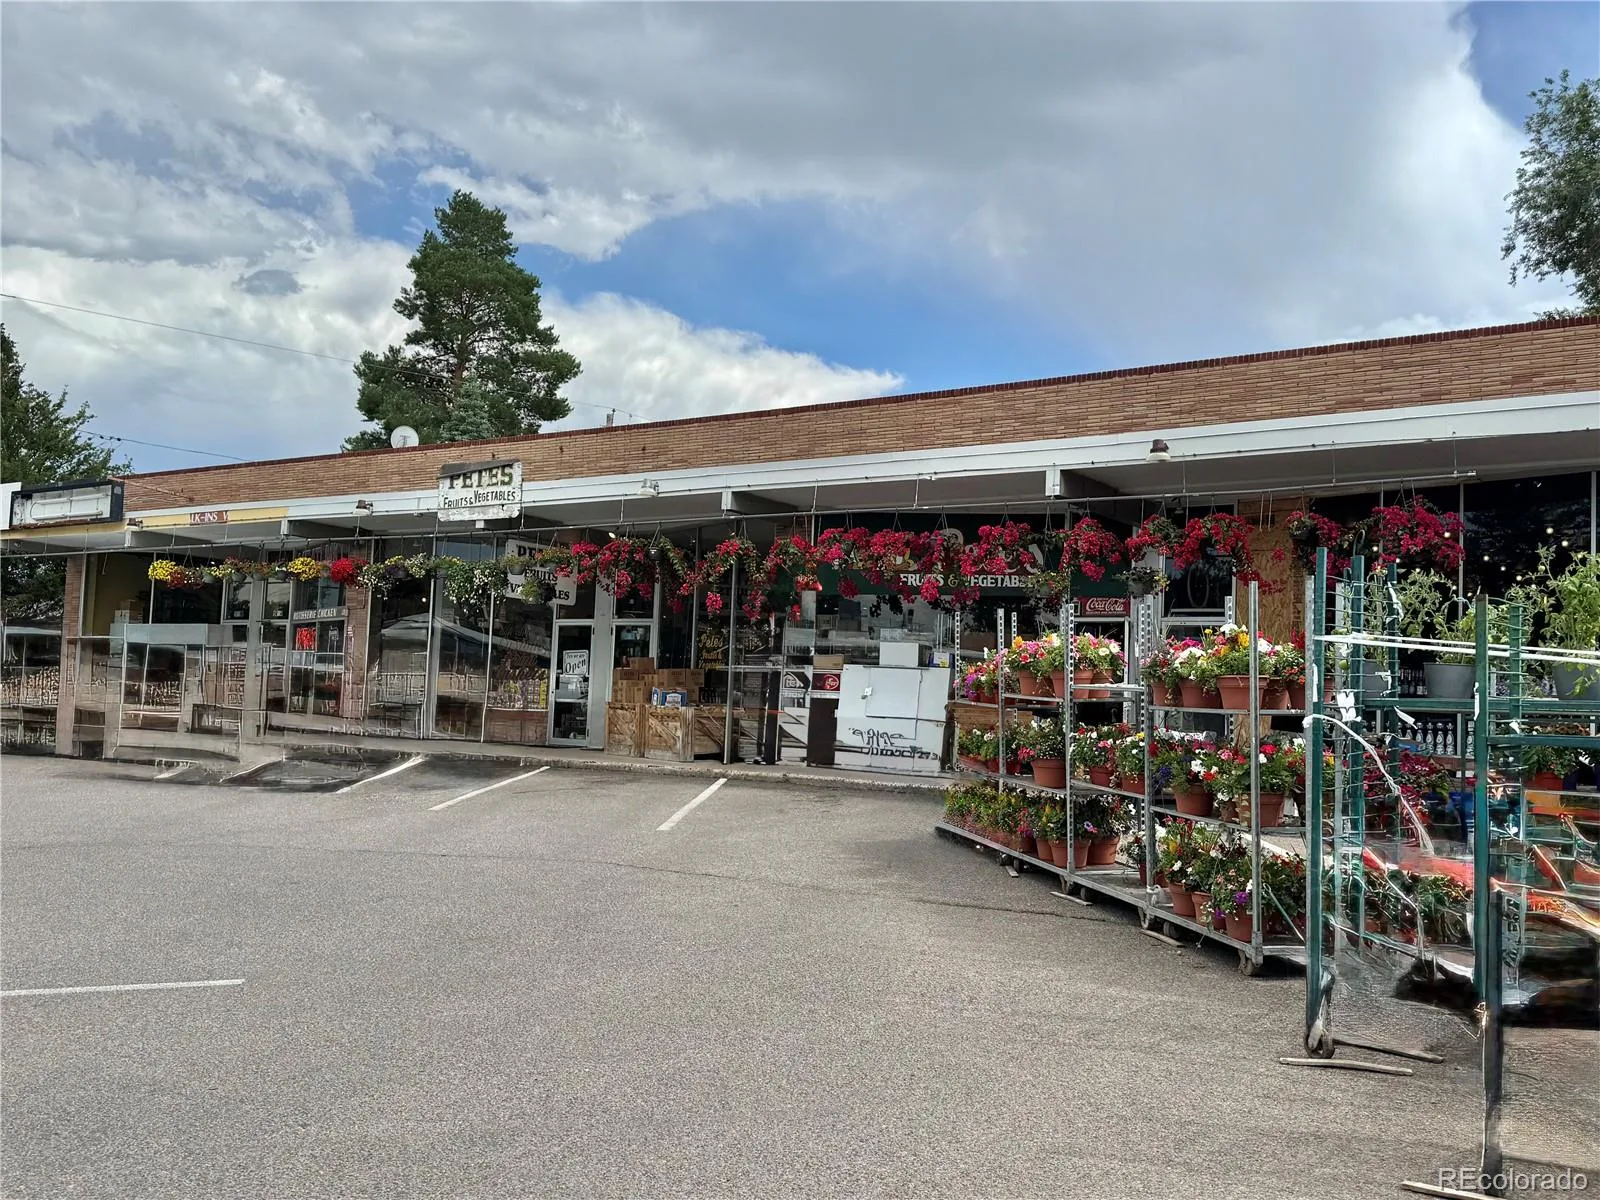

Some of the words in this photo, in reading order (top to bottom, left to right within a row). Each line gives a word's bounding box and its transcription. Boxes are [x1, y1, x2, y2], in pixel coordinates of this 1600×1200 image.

[474, 490, 516, 505] VEGETABLES
[899, 573, 945, 588] FRUS
[947, 573, 959, 588] &
[565, 659, 587, 673] Open
